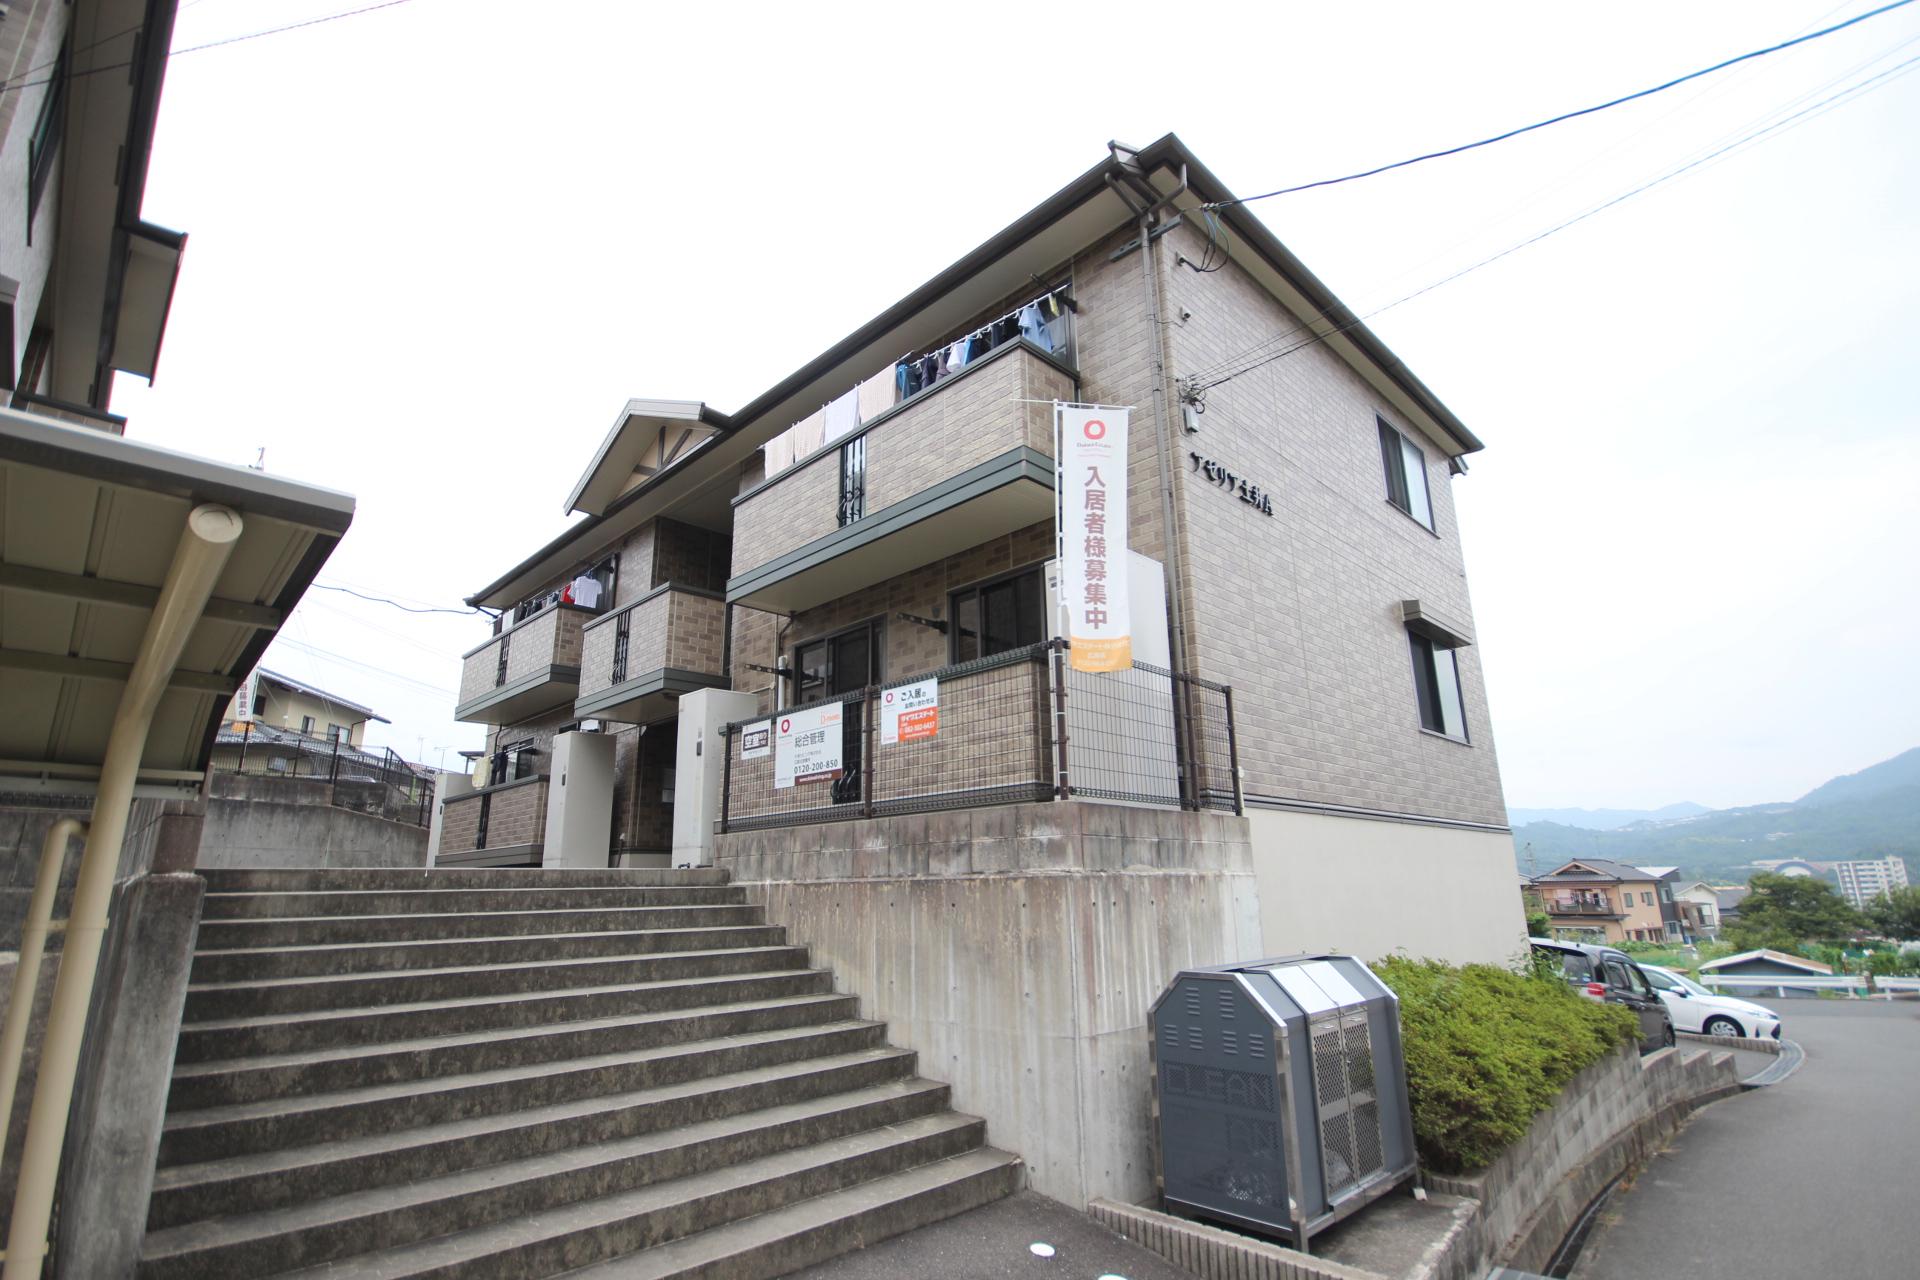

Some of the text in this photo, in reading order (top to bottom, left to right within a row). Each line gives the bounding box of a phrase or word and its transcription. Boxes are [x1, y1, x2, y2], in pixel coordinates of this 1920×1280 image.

[1084, 466, 1108, 630] 入居者様募集中
[794, 730, 825, 748] 総合管理
[794, 759, 838, 774] 0120-200-850
[1165, 1063, 1272, 1110] CLEAN
